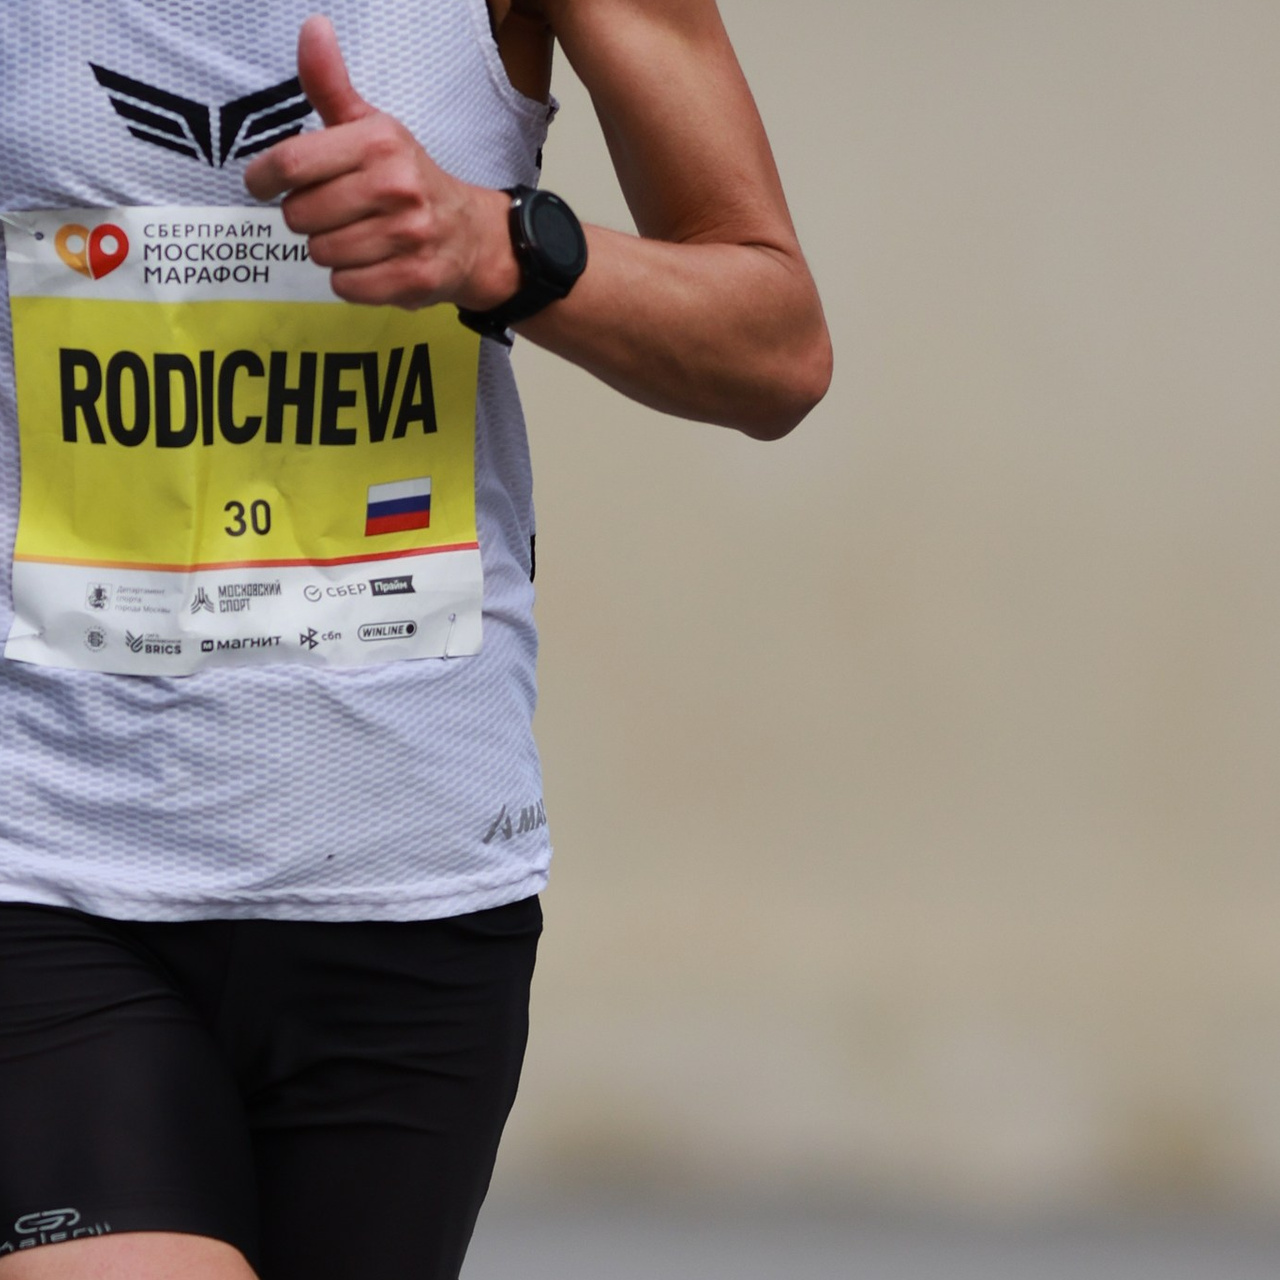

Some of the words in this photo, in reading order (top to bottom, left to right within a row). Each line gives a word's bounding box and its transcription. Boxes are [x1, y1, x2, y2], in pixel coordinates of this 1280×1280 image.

[143, 220, 272, 239] СБЕРПРАЙМ
[143, 265, 270, 284] МАРАФОН
[59, 342, 438, 448] RODICHEVA
[223, 499, 272, 537] 30
[218, 578, 282, 599] МОСКОВСКИЙ
[326, 582, 367, 597] СБЕР
[219, 598, 251, 613] СПОРТ
[362, 624, 405, 638] WINLINE
[144, 644, 182, 655] BRICS
